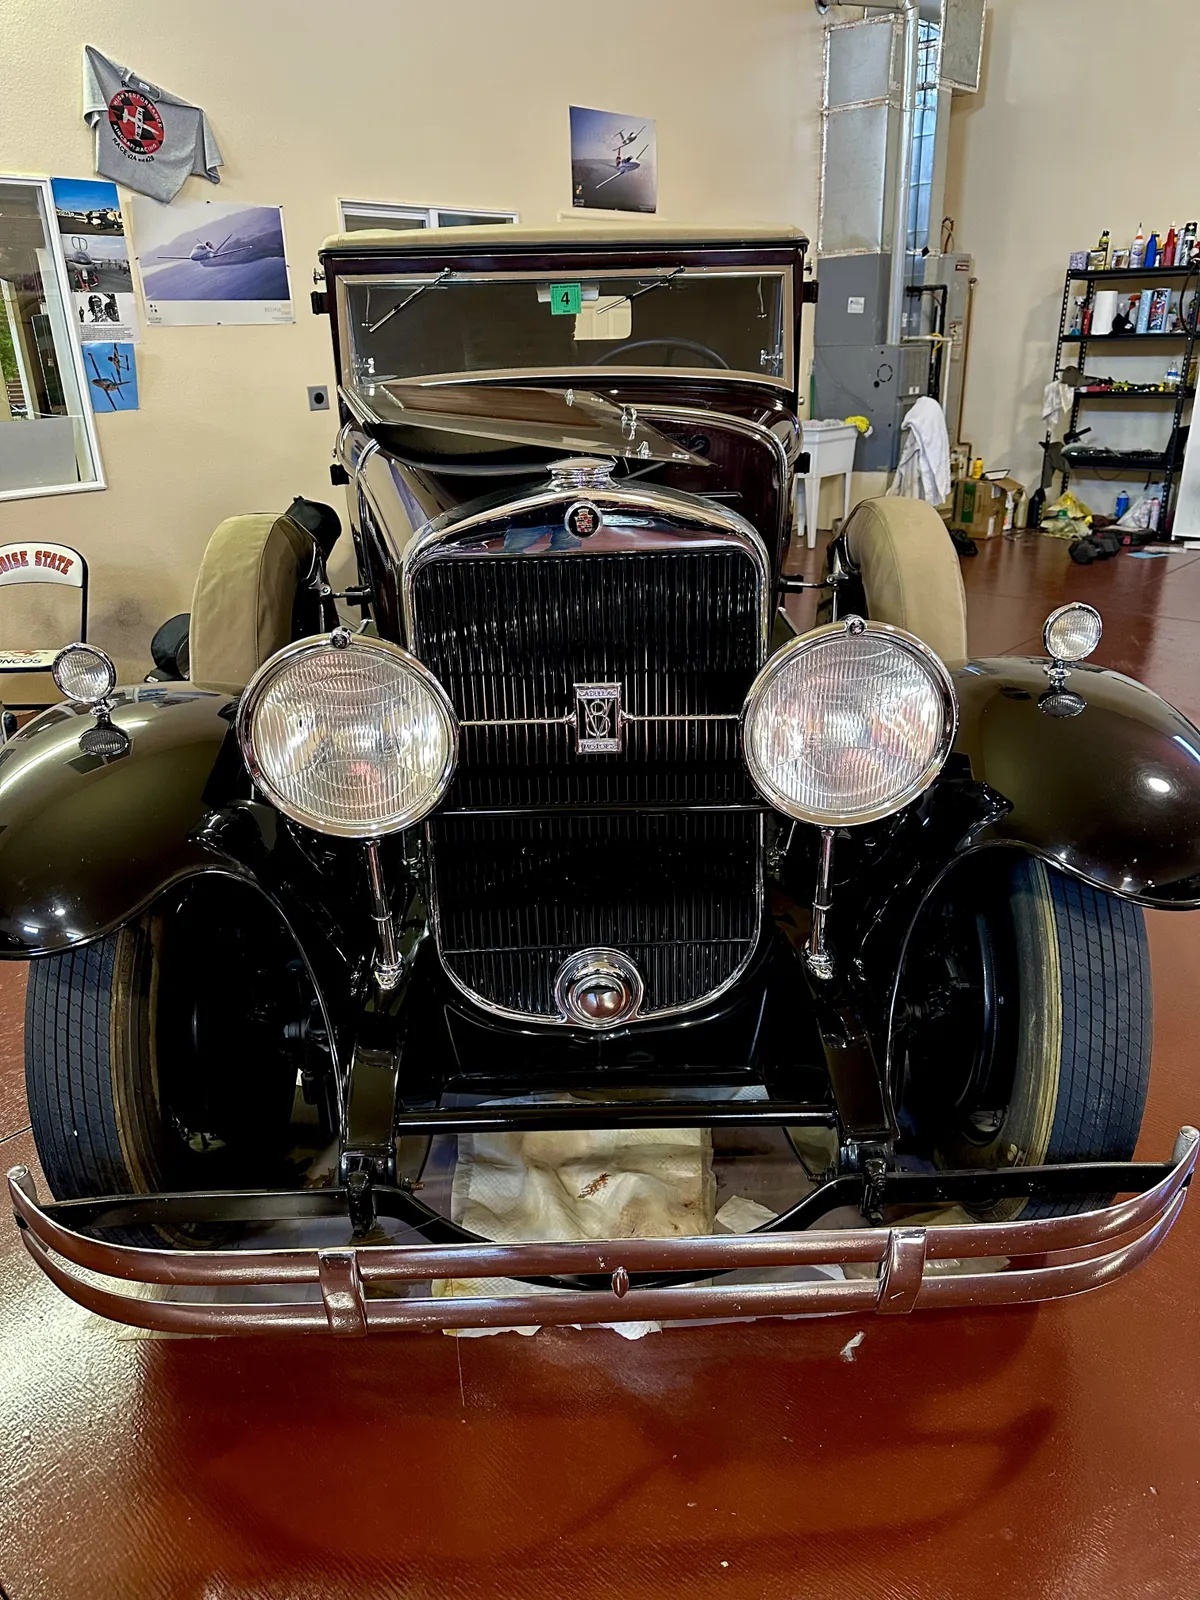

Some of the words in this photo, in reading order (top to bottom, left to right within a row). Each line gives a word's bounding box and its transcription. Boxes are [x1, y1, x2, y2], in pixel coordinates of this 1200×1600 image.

[125, 92, 162, 128] PERFORMANCE
[112, 137, 128, 156] RACE
[561, 291, 570, 305] 4
[34, 550, 75, 575] STATE
[578, 688, 617, 697] CADILLAC
